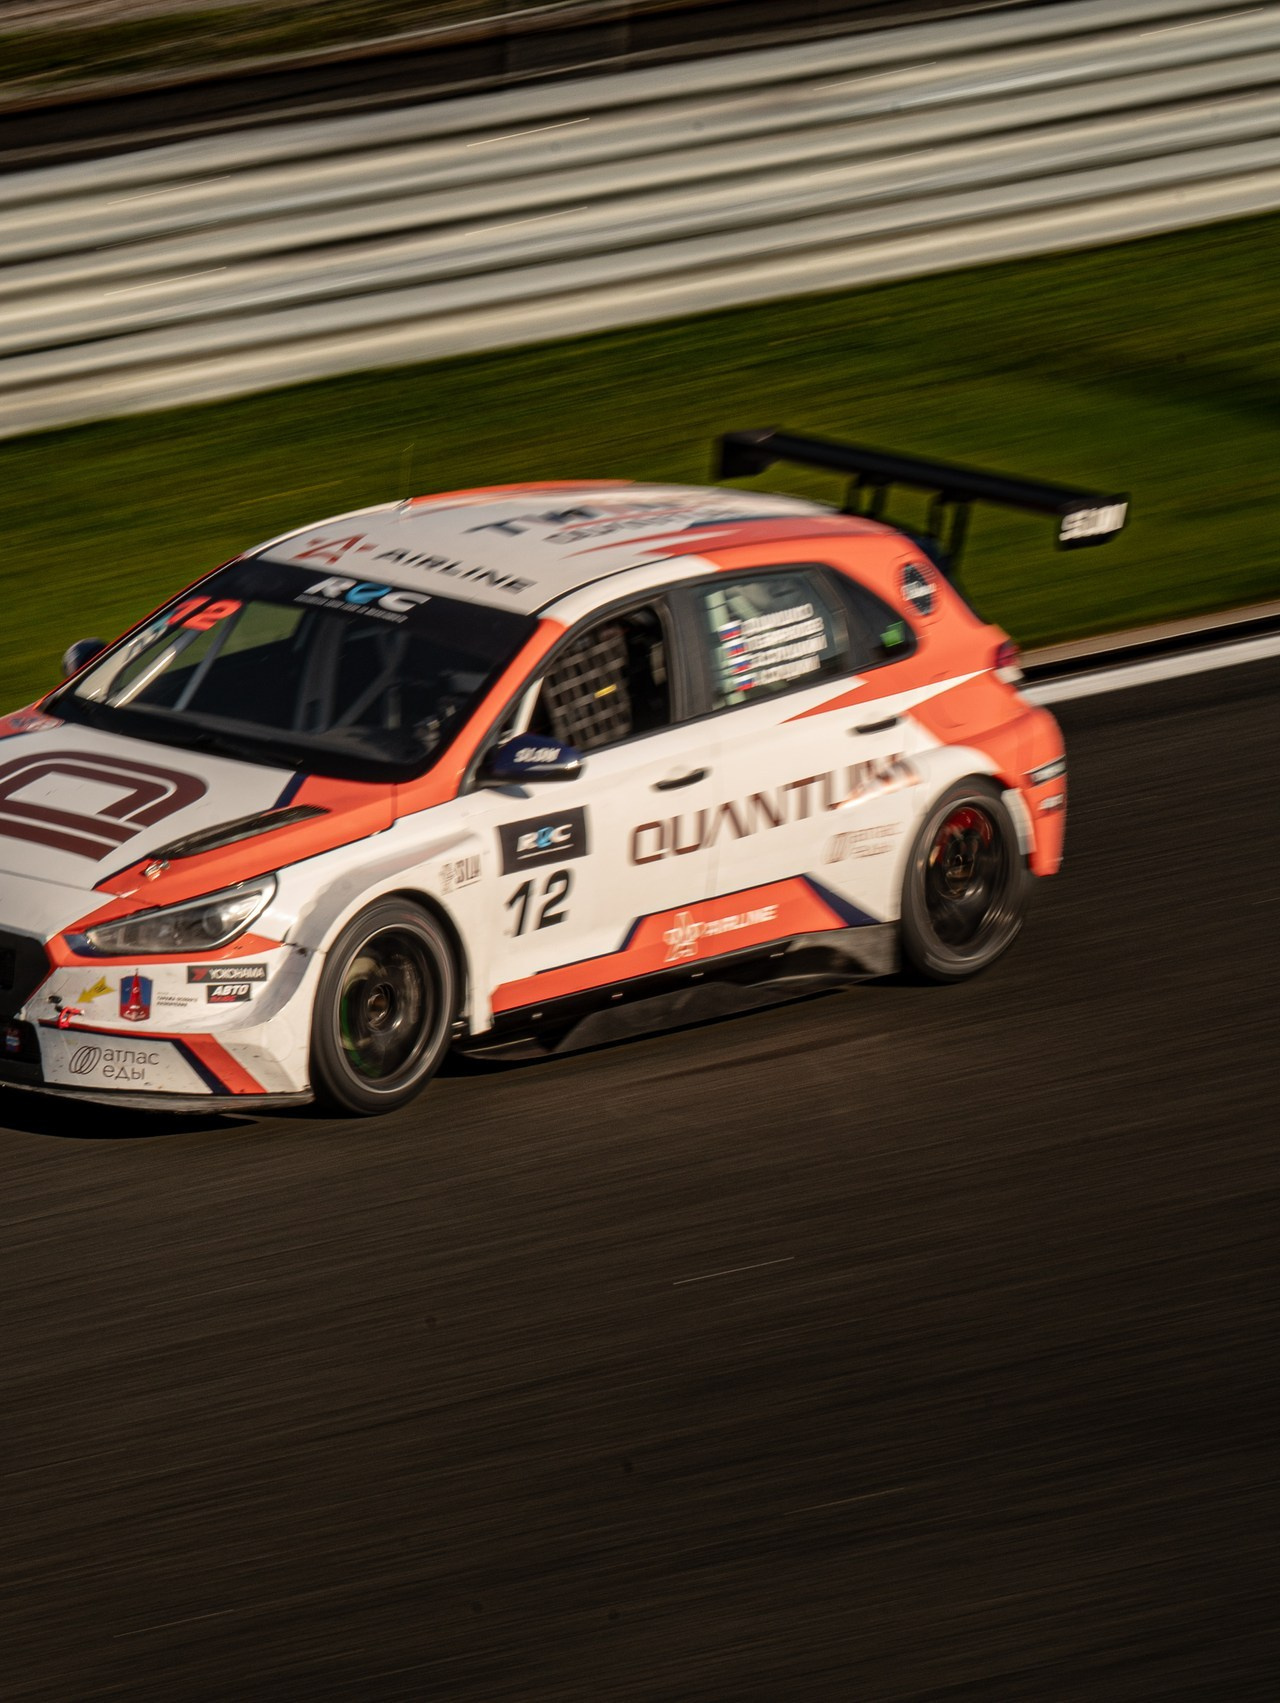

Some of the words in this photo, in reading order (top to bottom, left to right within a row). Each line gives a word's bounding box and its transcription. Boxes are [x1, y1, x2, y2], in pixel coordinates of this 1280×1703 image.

[372, 547, 538, 595] AIRLINE
[164, 595, 242, 631] 12
[504, 868, 574, 938] 12
[209, 966, 266, 980] YOKOHAMA
[103, 1047, 160, 1066] атлас
[102, 1064, 146, 1081] еды
